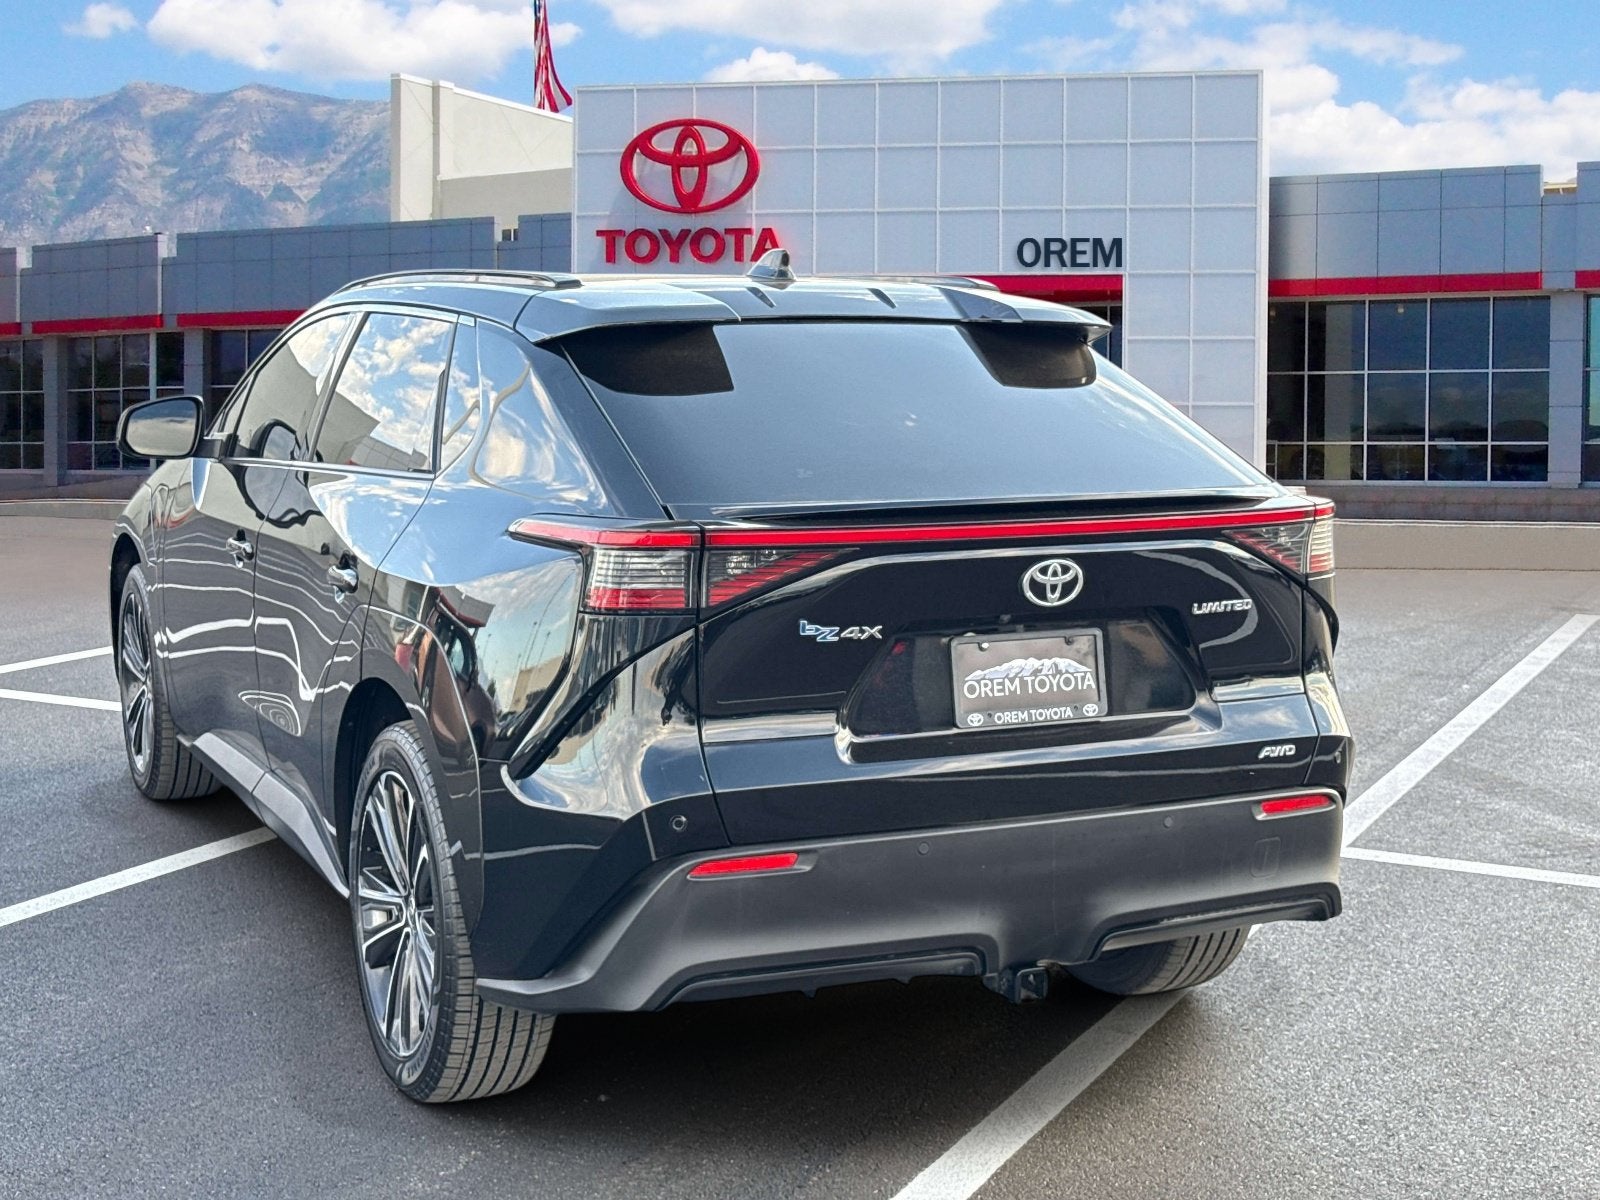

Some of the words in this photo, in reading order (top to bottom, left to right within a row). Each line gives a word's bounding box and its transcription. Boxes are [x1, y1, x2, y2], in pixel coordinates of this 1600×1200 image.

[596, 228, 781, 264] TOYOTA
[1017, 237, 1122, 267] OREM
[1192, 599, 1252, 614] LIMITED
[963, 678, 1020, 698] OREM
[1024, 672, 1096, 694] TOYOTA
[994, 711, 1027, 724] OREM
[1030, 706, 1073, 721] TOYOTA
[1258, 744, 1296, 759] AWD
